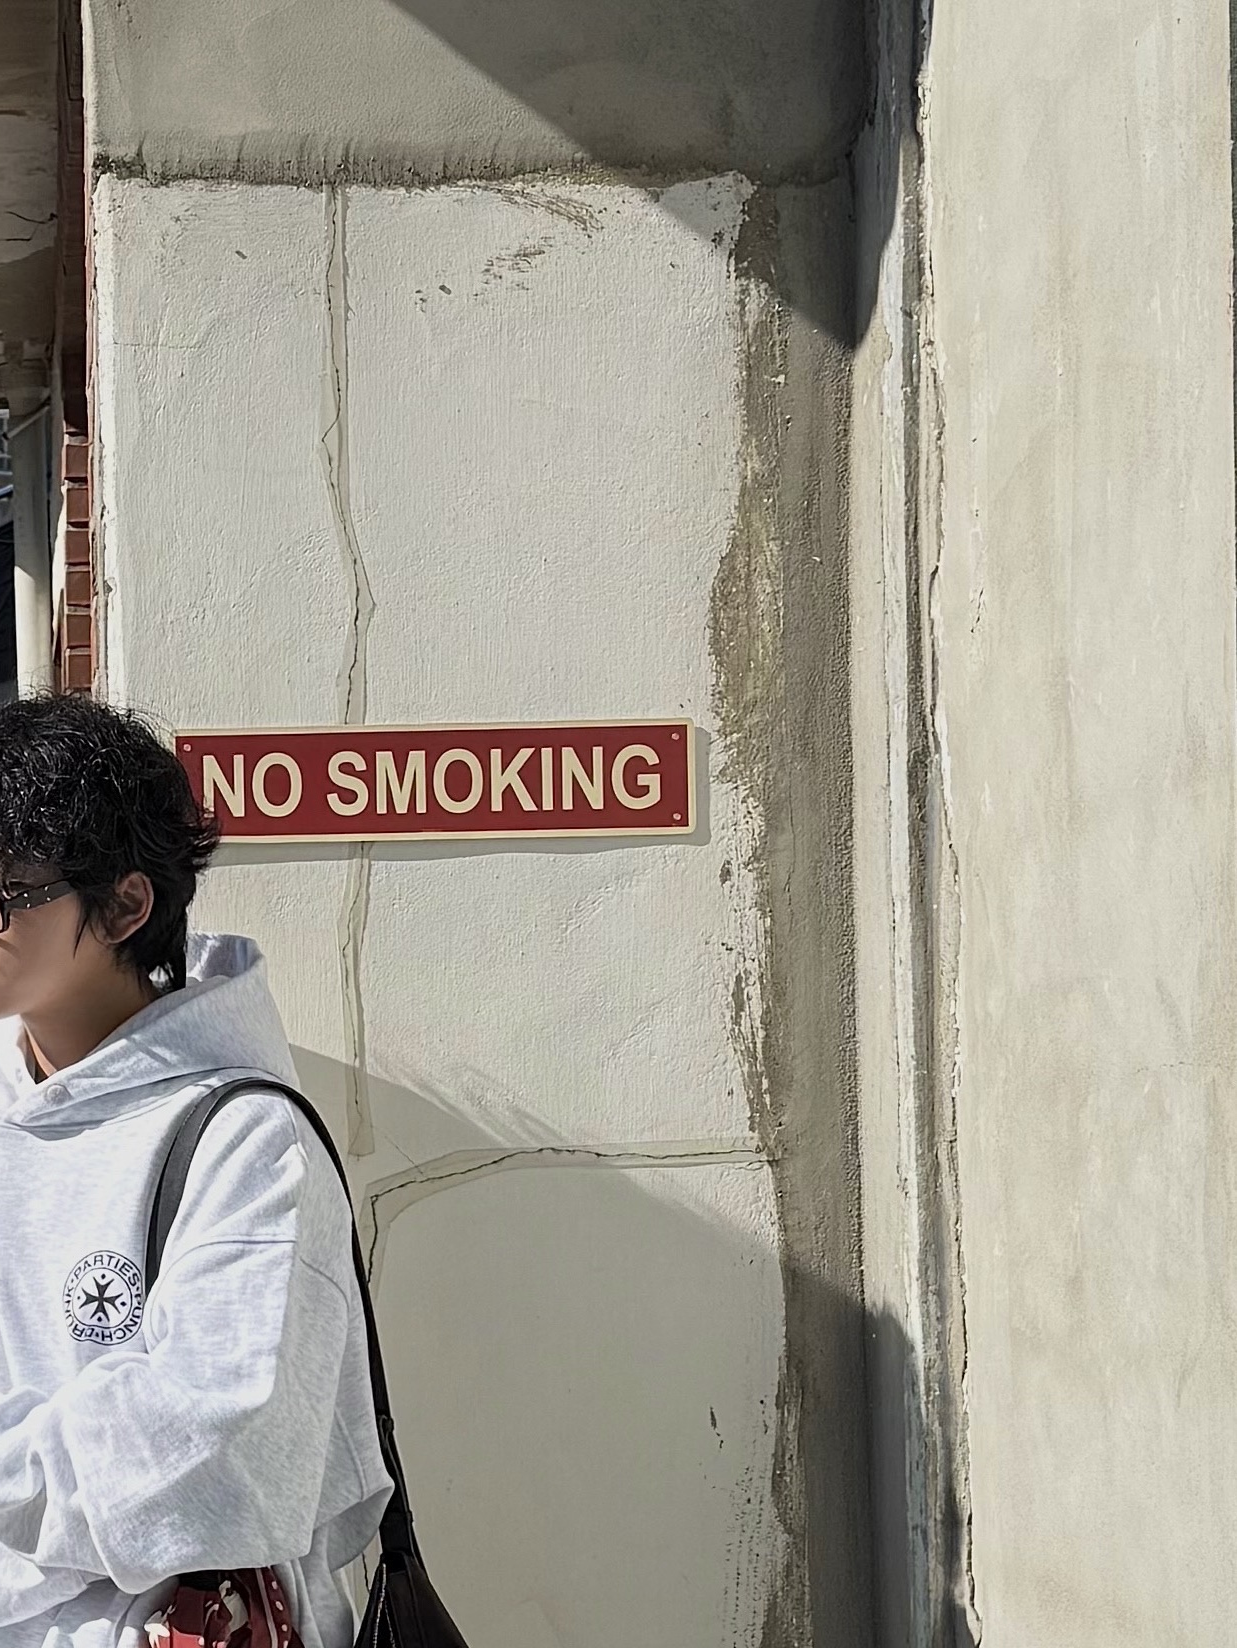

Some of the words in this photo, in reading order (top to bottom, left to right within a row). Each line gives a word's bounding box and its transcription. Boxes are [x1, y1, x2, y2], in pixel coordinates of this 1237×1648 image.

[203, 751, 303, 818] NO
[326, 744, 662, 816] SMOKING
[74, 1254, 140, 1287] PARTIES
